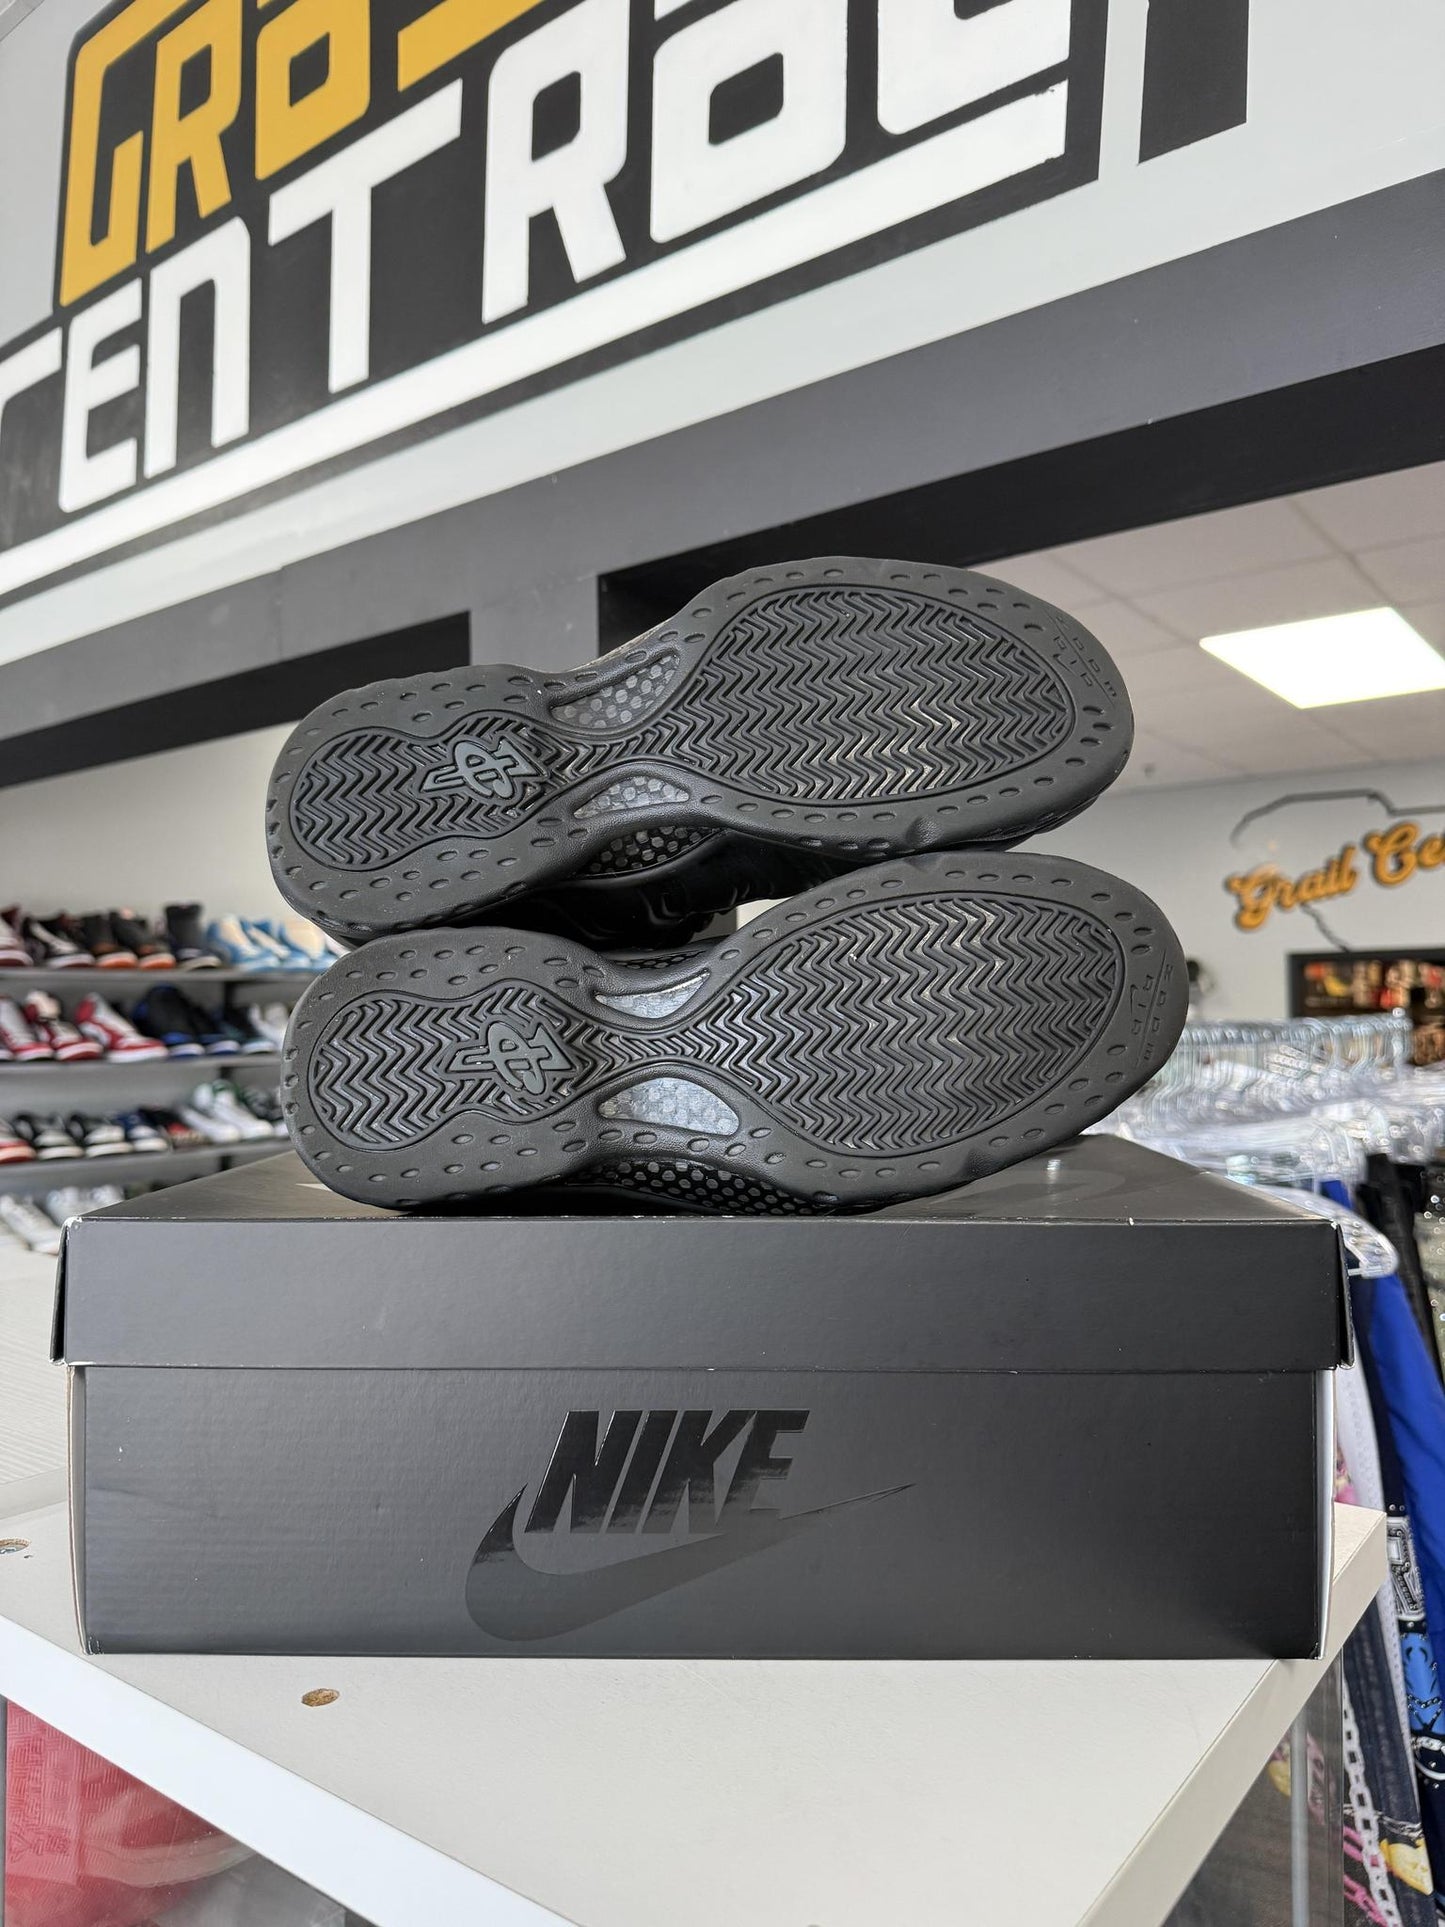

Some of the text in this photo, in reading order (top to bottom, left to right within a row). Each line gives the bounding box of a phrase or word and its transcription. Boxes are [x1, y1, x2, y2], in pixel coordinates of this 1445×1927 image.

[1226, 821, 1445, 932] Grail Ce
[523, 1409, 811, 1534] NIKE
